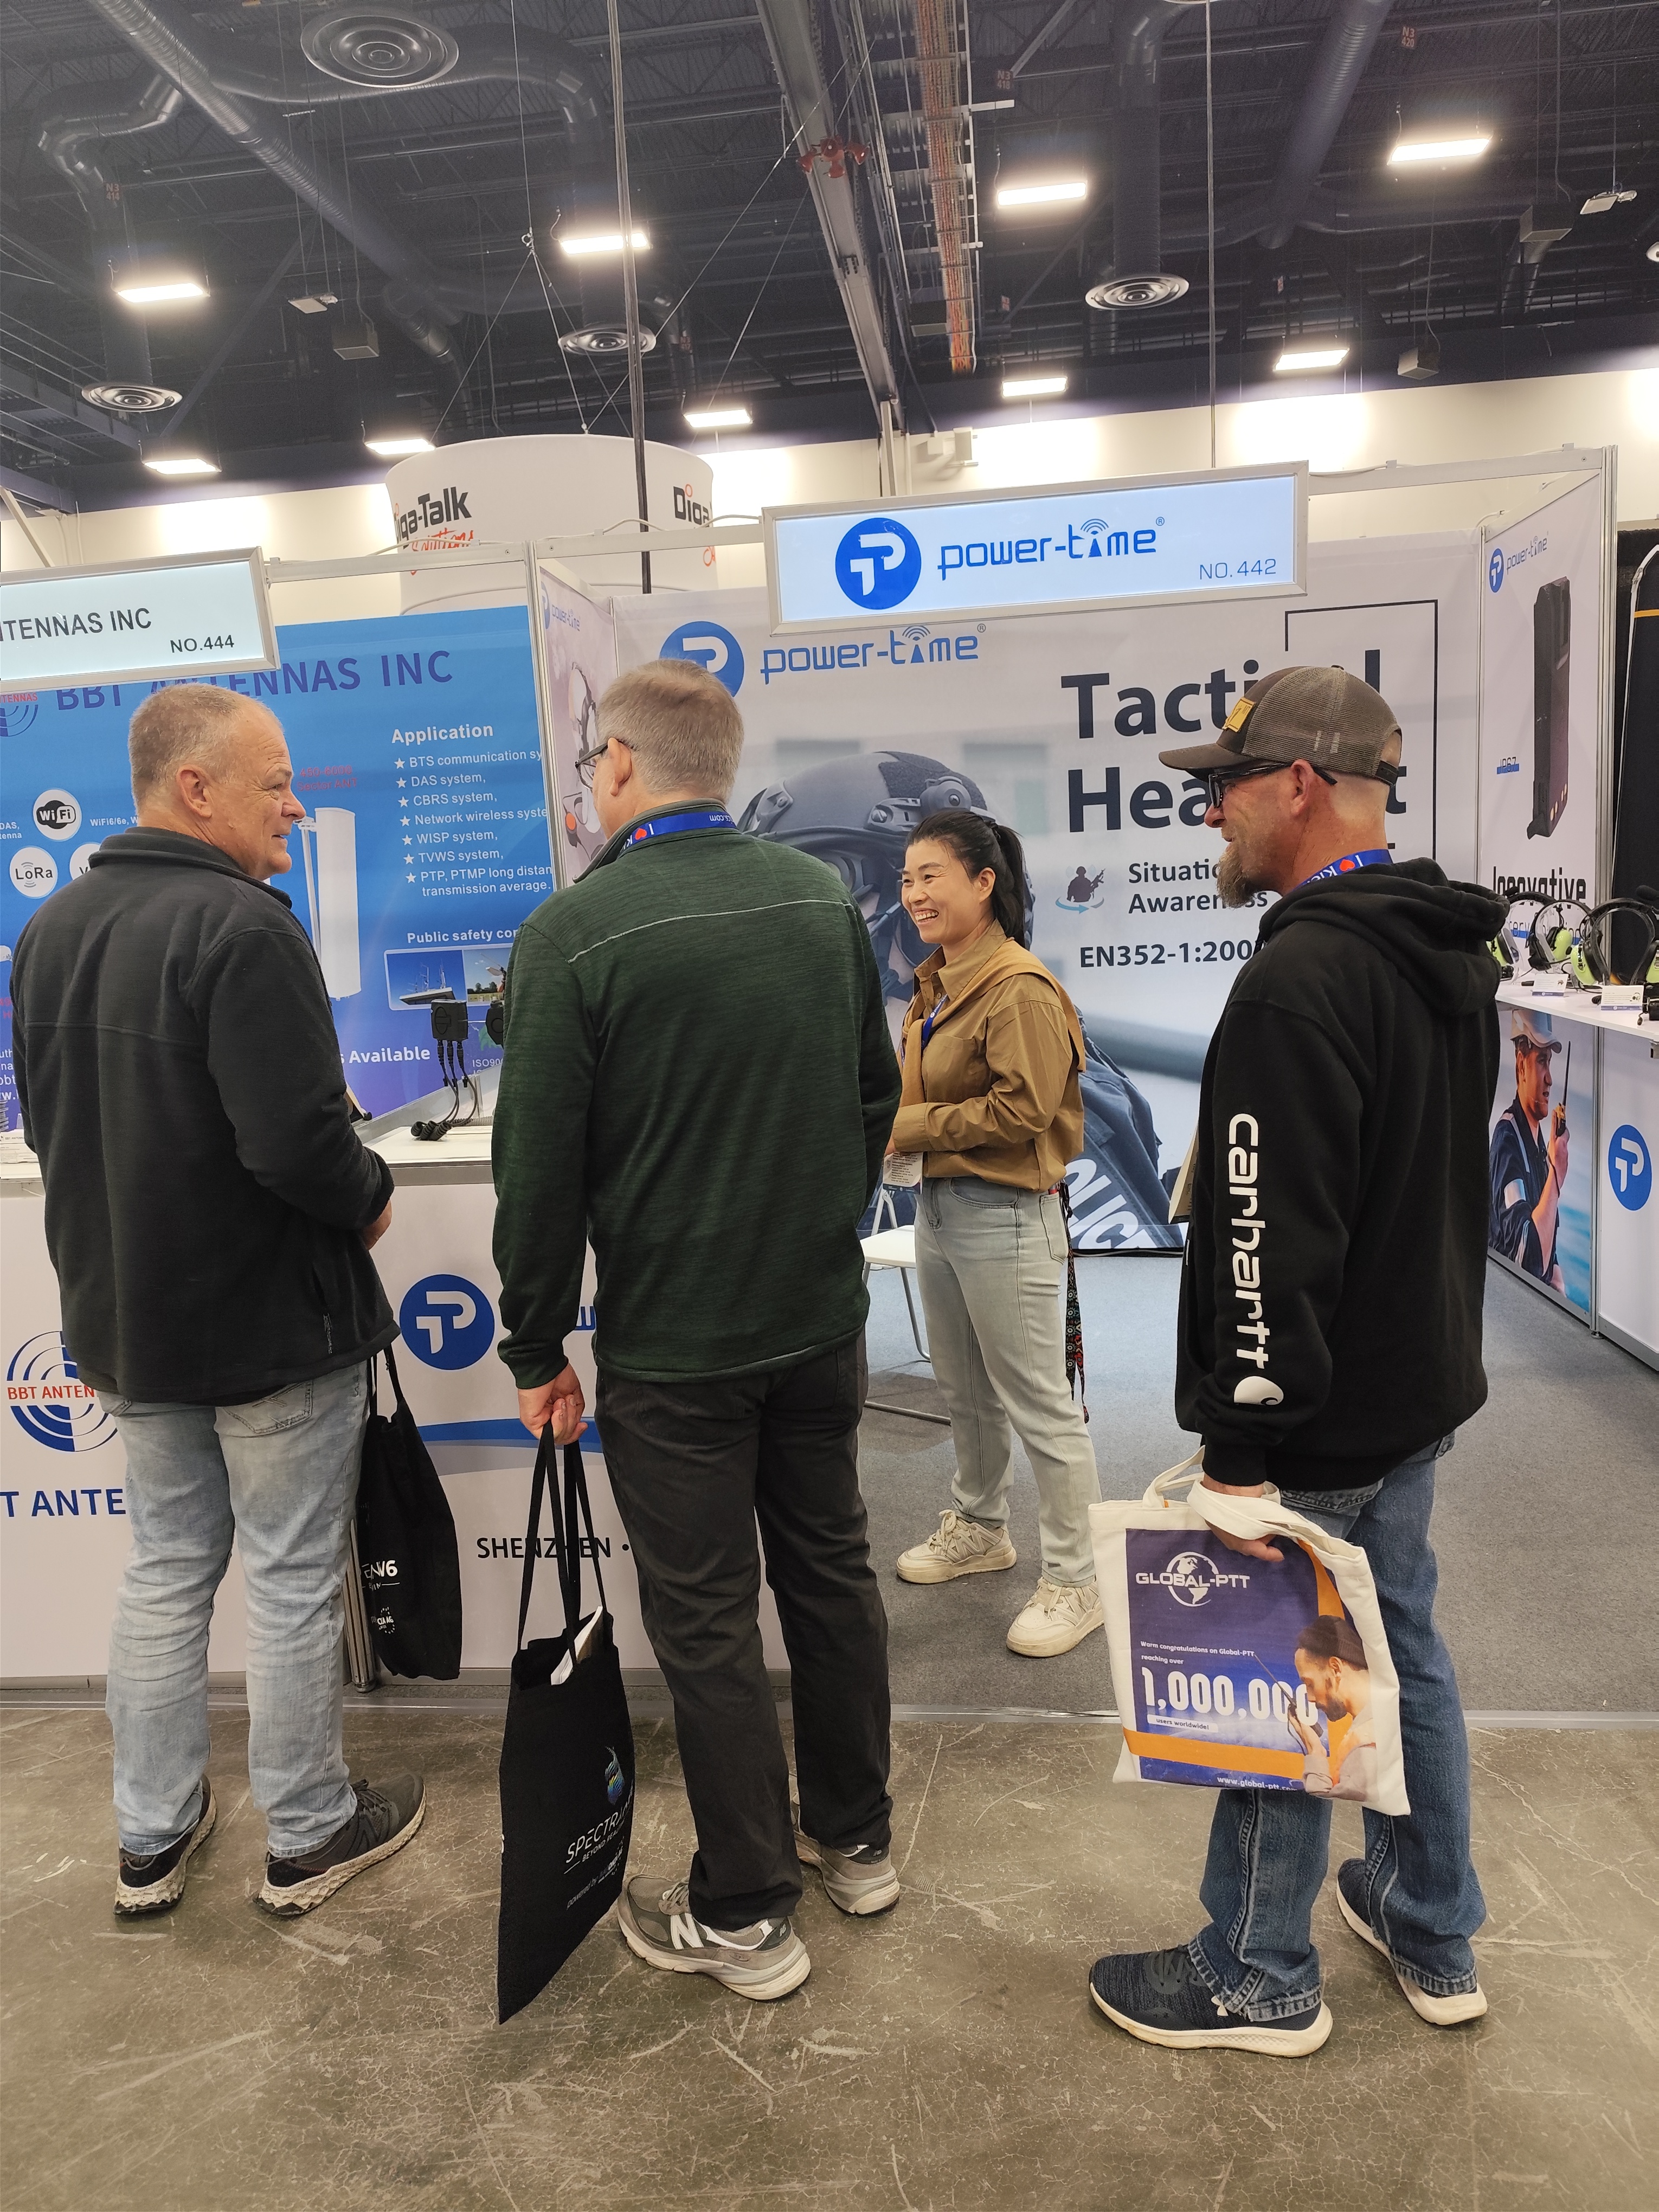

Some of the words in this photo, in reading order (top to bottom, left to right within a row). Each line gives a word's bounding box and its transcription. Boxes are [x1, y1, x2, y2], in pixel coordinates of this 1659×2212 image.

[1198, 558, 1277, 581] NO.442
[0, 613, 102, 642] TENNAS
[112, 607, 152, 632] INC
[170, 635, 235, 653] NO.444
[381, 651, 453, 687] INC
[391, 724, 494, 746] Application
[409, 756, 434, 768] BTS
[437, 750, 526, 766] communication
[1500, 756, 1516, 773] IP67
[335, 777, 357, 789] ANT
[411, 775, 438, 787] DAS
[440, 773, 486, 787] system,
[413, 794, 448, 806] CBRS
[451, 792, 497, 805] system,
[415, 812, 463, 825] Network
[465, 809, 515, 822] wireless
[416, 832, 449, 844] WISP
[452, 831, 498, 844] system,
[419, 850, 455, 863] TVWS
[458, 848, 504, 863] system,
[15, 867, 53, 880] LoRa
[421, 870, 448, 882] PTP,
[451, 868, 486, 880] PTMP
[488, 867, 514, 879] long
[422, 883, 497, 897] transmission
[499, 881, 551, 893] average.
[407, 931, 449, 943] Public
[452, 929, 493, 942] safety
[1080, 940, 1253, 968] EN352-1:200
[349, 1046, 430, 1064] Available
[1227, 1113, 1270, 1369] carhartt
[8, 1387, 37, 1400] BBT
[477, 1538, 611, 1559] SHEZEN
[1136, 1572, 1250, 1589] GLOBAL-PTT
[1160, 1643, 1208, 1654] congratulations
[1219, 1648, 1255, 1657] Global-PTT
[1141, 1655, 1168, 1664] reaching
[1174, 1721, 1210, 1731] worldwide!
